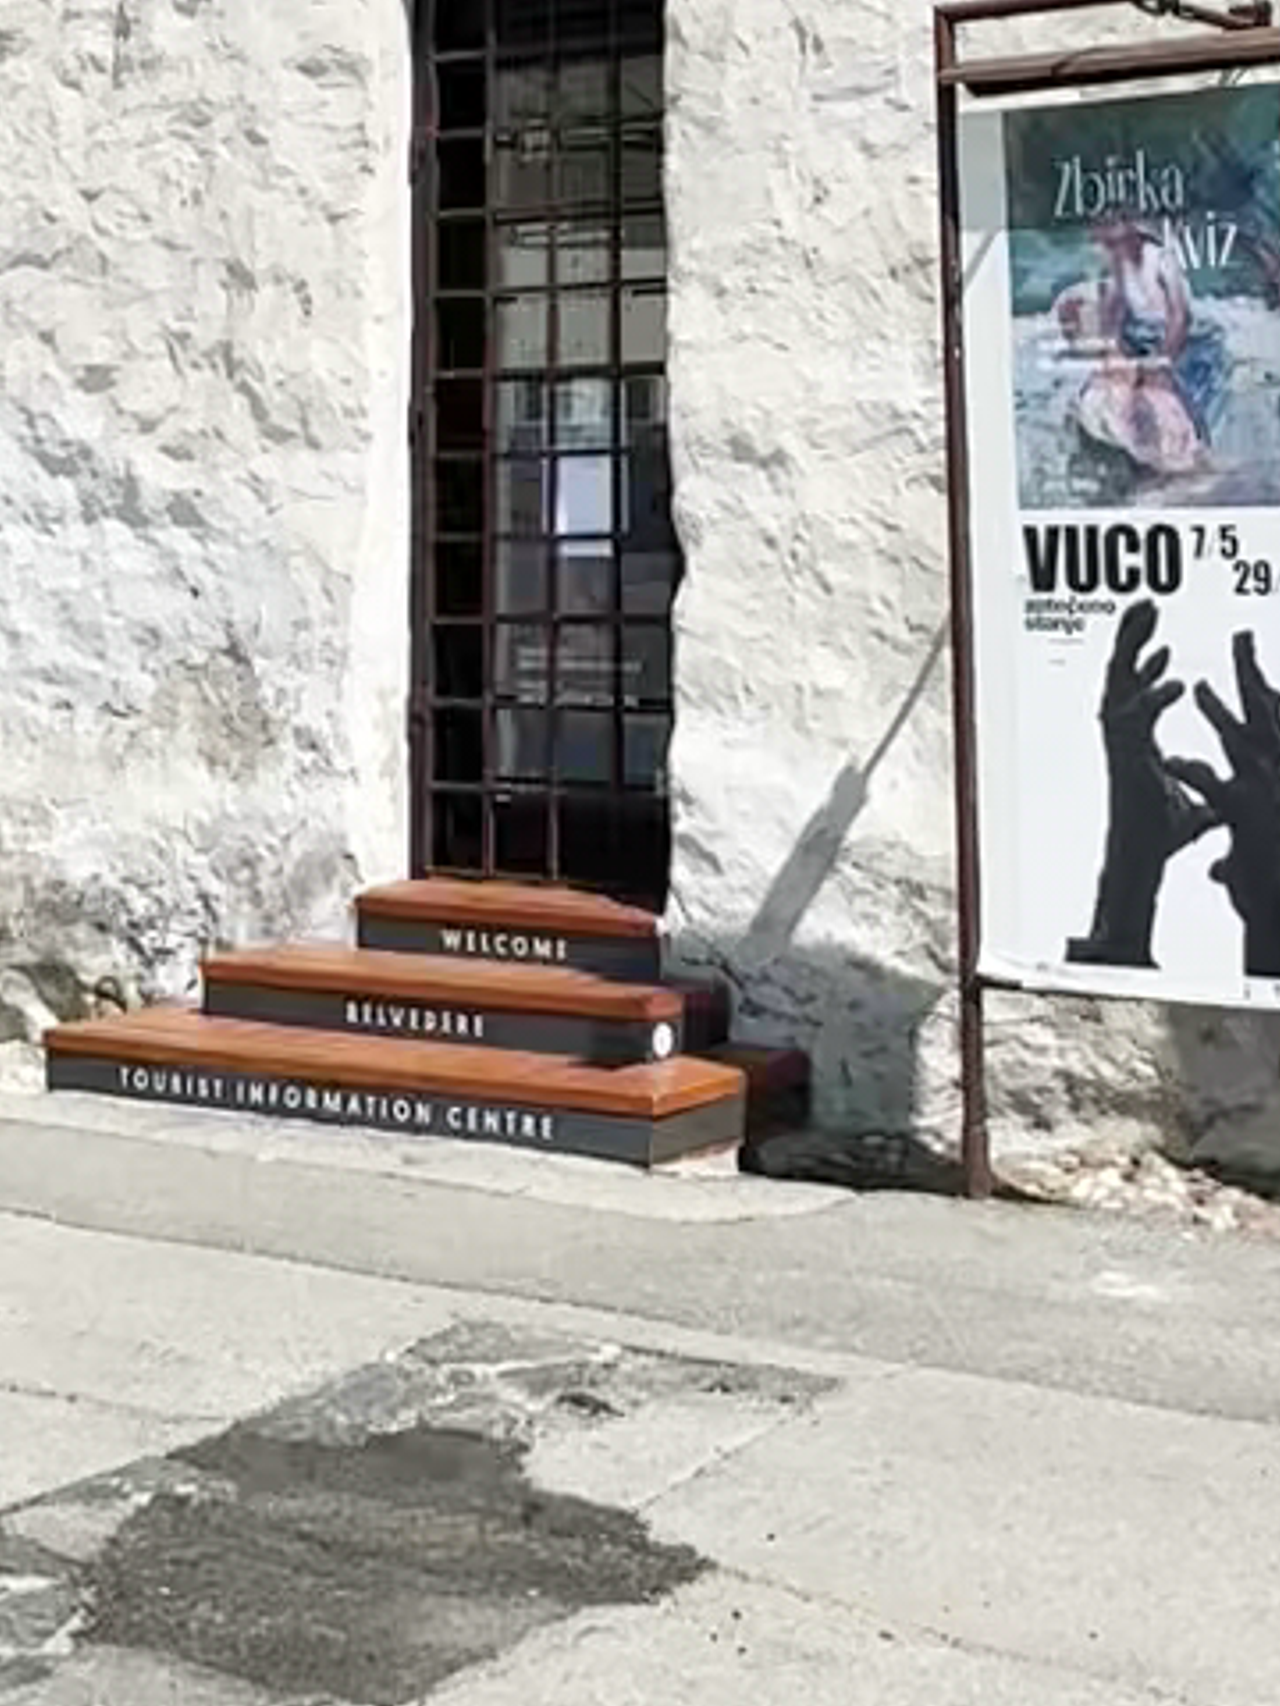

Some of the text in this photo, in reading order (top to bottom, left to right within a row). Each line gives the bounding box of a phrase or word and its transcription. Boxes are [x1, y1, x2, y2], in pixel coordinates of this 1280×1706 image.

[1051, 149, 1186, 217] Zbirka
[1022, 523, 1183, 595] VUCO
[440, 929, 568, 962] WELCOME
[346, 1001, 485, 1039] BELVEDERE
[120, 1066, 556, 1141] TOURIST INFORMATION CENTRE
